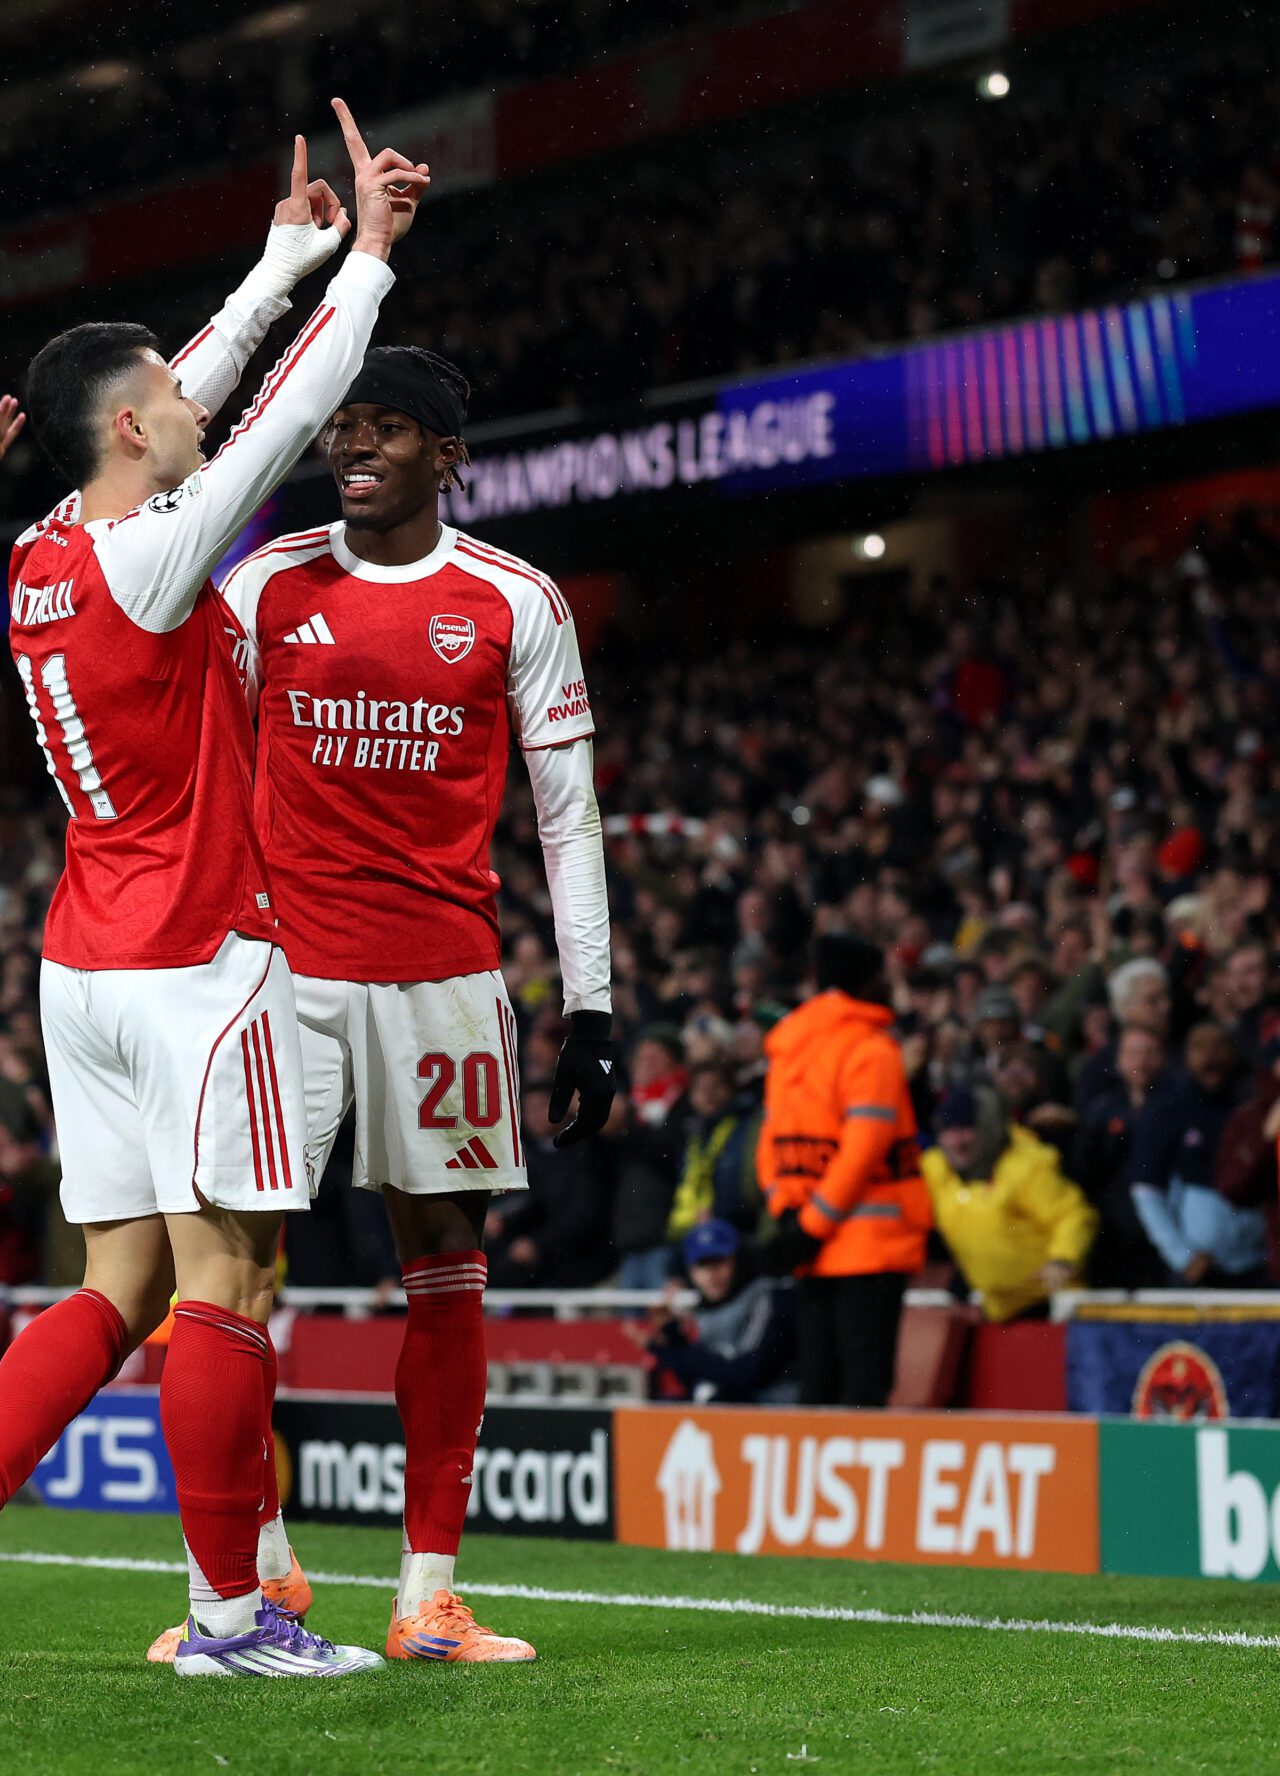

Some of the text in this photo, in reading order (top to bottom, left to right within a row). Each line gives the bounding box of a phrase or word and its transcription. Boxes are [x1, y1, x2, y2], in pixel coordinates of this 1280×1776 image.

[454, 392, 836, 523] CHAMPIONS LEAGUE
[436, 622, 469, 633] Arsenal
[16, 653, 118, 820] 11
[287, 690, 465, 736] Emirates
[312, 734, 440, 772] FLY BETTER
[416, 1051, 503, 1130] 20
[39, 1416, 160, 1501] S5
[298, 1428, 609, 1526] masrcard
[737, 1434, 1056, 1558] JUST EAT
[1196, 1428, 1280, 1581] b
